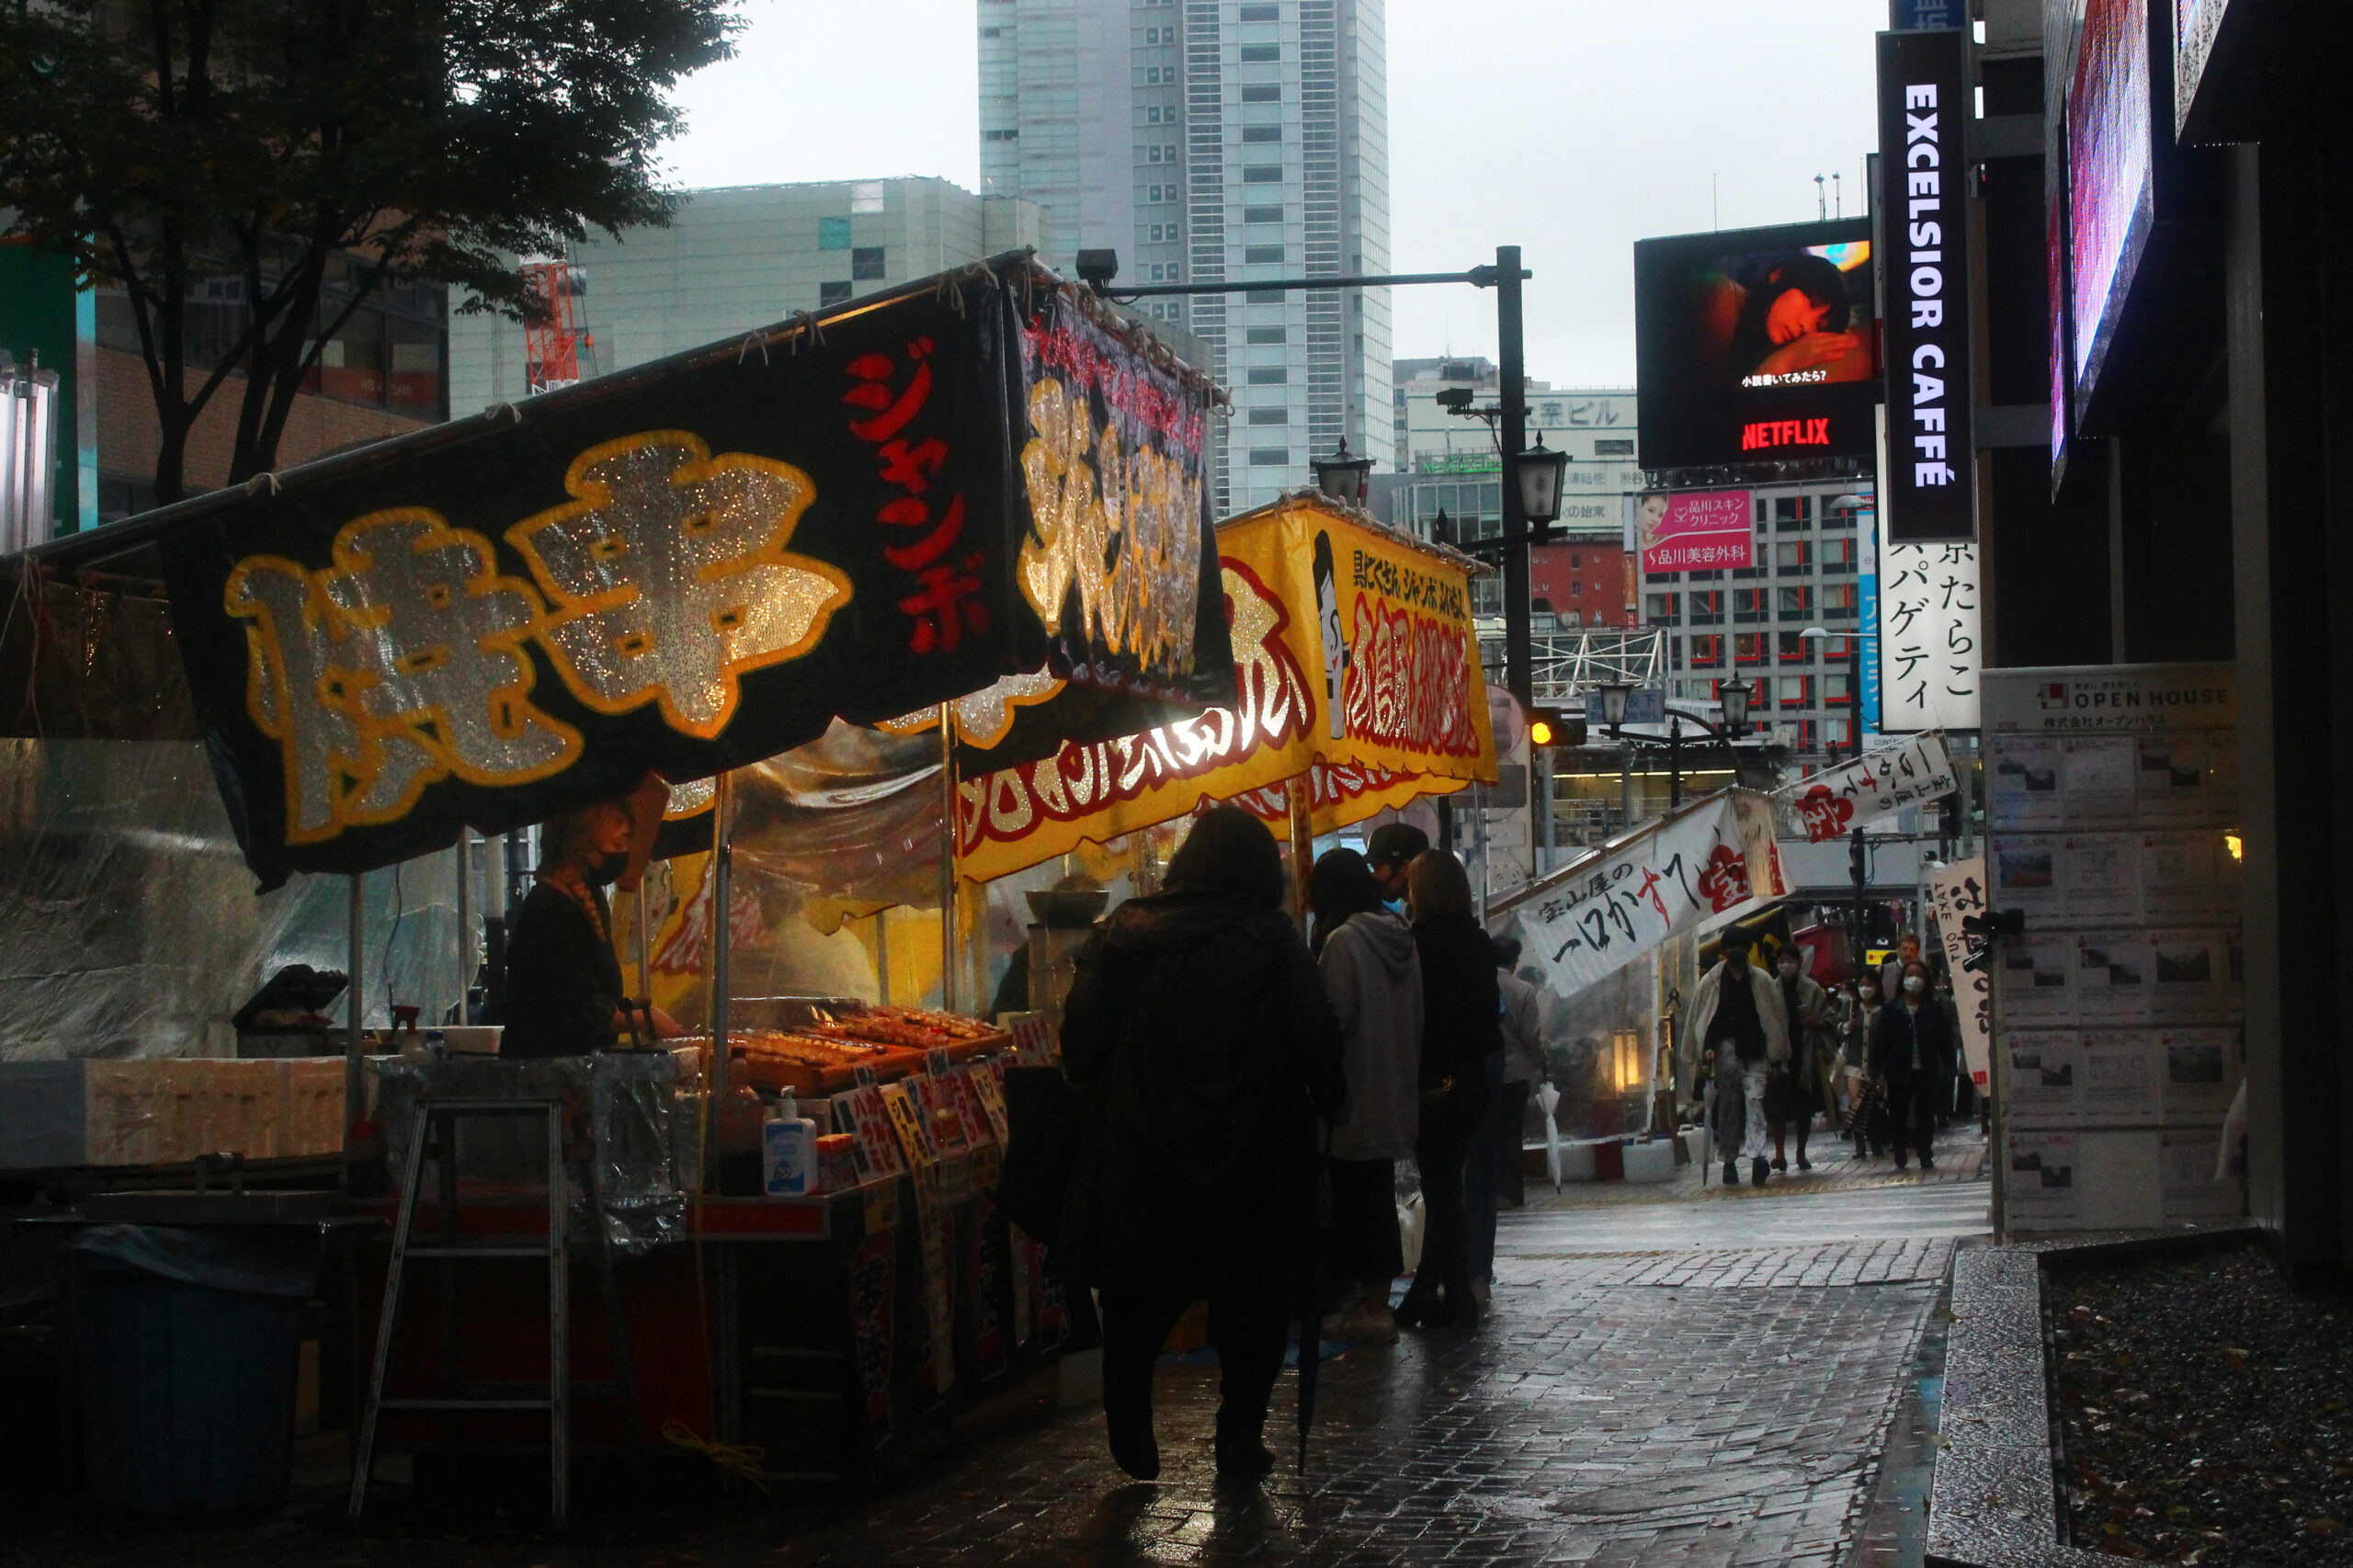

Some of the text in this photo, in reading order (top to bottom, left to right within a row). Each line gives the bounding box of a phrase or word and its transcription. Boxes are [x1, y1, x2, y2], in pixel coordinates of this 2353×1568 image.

[1905, 84, 1956, 488] EXCELSIOR CAFFÉ
[1742, 417, 1829, 450] NETFLIX
[840, 336, 991, 656] ジャンボ
[1688, 498, 1745, 513] 品川スキン
[1689, 512, 1740, 528] クリニック
[1658, 544, 1746, 565] 品川美容外科
[2075, 688, 2229, 710] OPEN HOUSE
[2043, 713, 2167, 730] 株式会社オープンハウス
[1538, 862, 1633, 925] 宝山屋の
[1934, 881, 1961, 963] TAKE OUT
